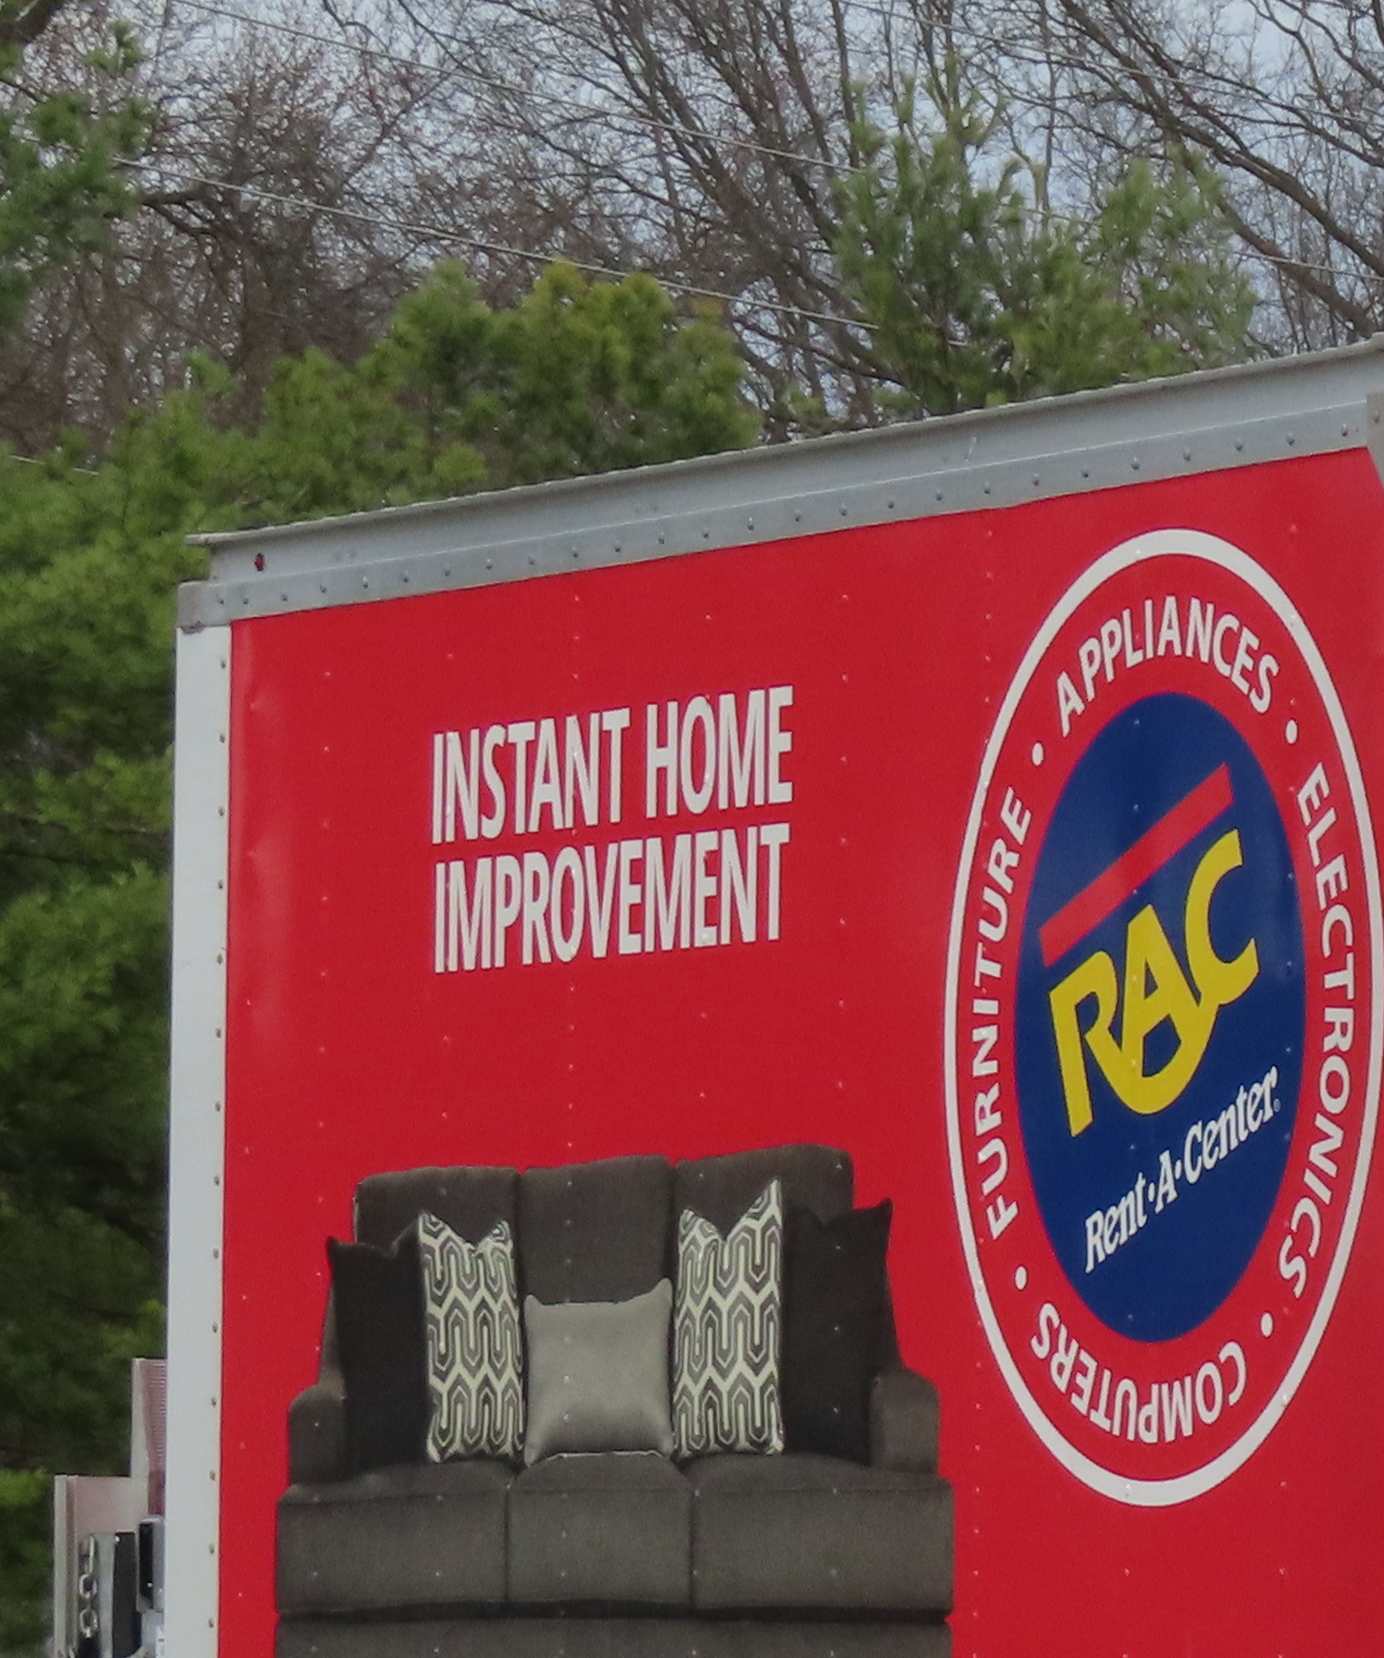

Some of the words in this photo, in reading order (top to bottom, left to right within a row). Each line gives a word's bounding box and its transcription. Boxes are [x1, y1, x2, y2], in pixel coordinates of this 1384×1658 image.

[1055, 595, 1279, 738] APPLIANCES
[432, 706, 630, 844] INSTANT
[646, 685, 794, 818] HOME
[434, 822, 791, 974] IMPROVEMENT
[972, 786, 1032, 1240] FURNITURE
[1048, 828, 1260, 1138] RAC
[1277, 761, 1355, 1299] ELECTRONICS
[1030, 1301, 1247, 1444] COMPUTERS
